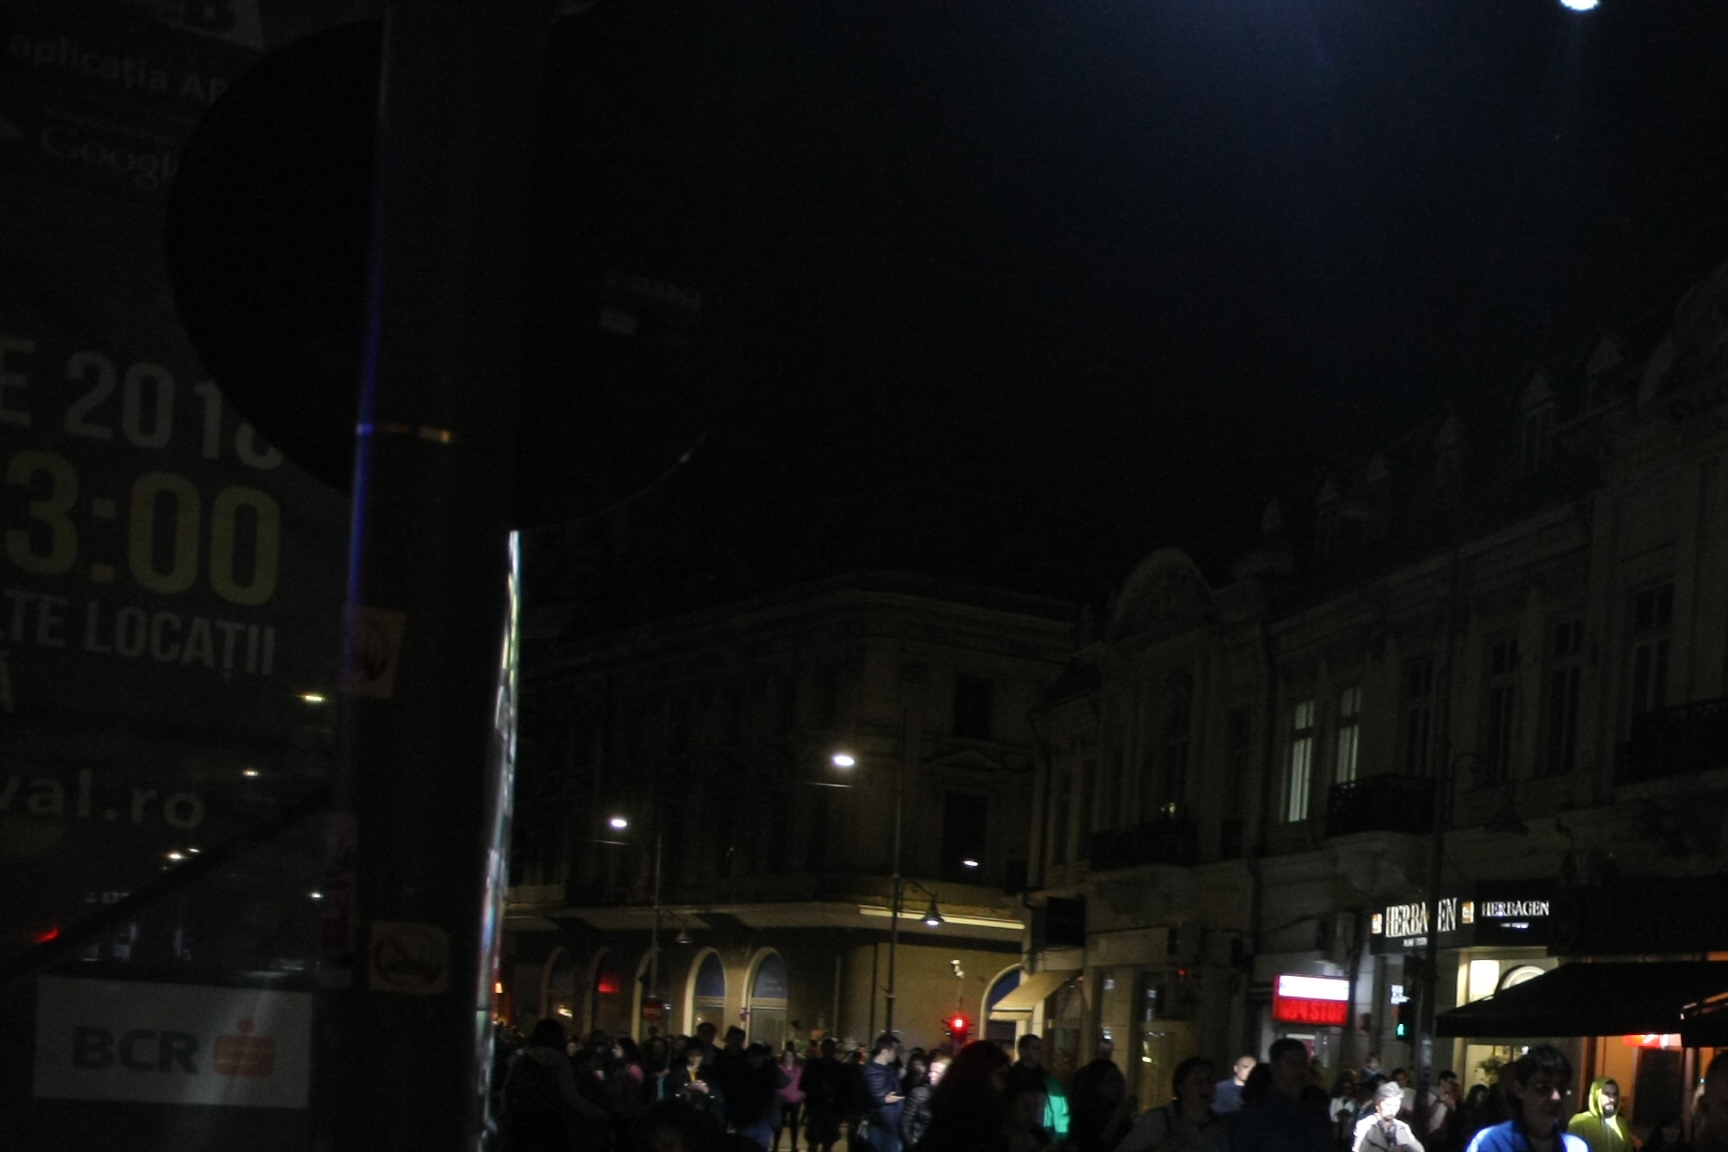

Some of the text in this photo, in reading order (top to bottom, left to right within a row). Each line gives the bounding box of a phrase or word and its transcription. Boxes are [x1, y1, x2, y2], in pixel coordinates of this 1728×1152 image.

[40, 122, 179, 191] Googl
[0, 588, 70, 649] TE
[1385, 897, 1458, 938] HERBAEN
[1481, 900, 1550, 917] HERBAGEN
[72, 1026, 199, 1074] BCR
